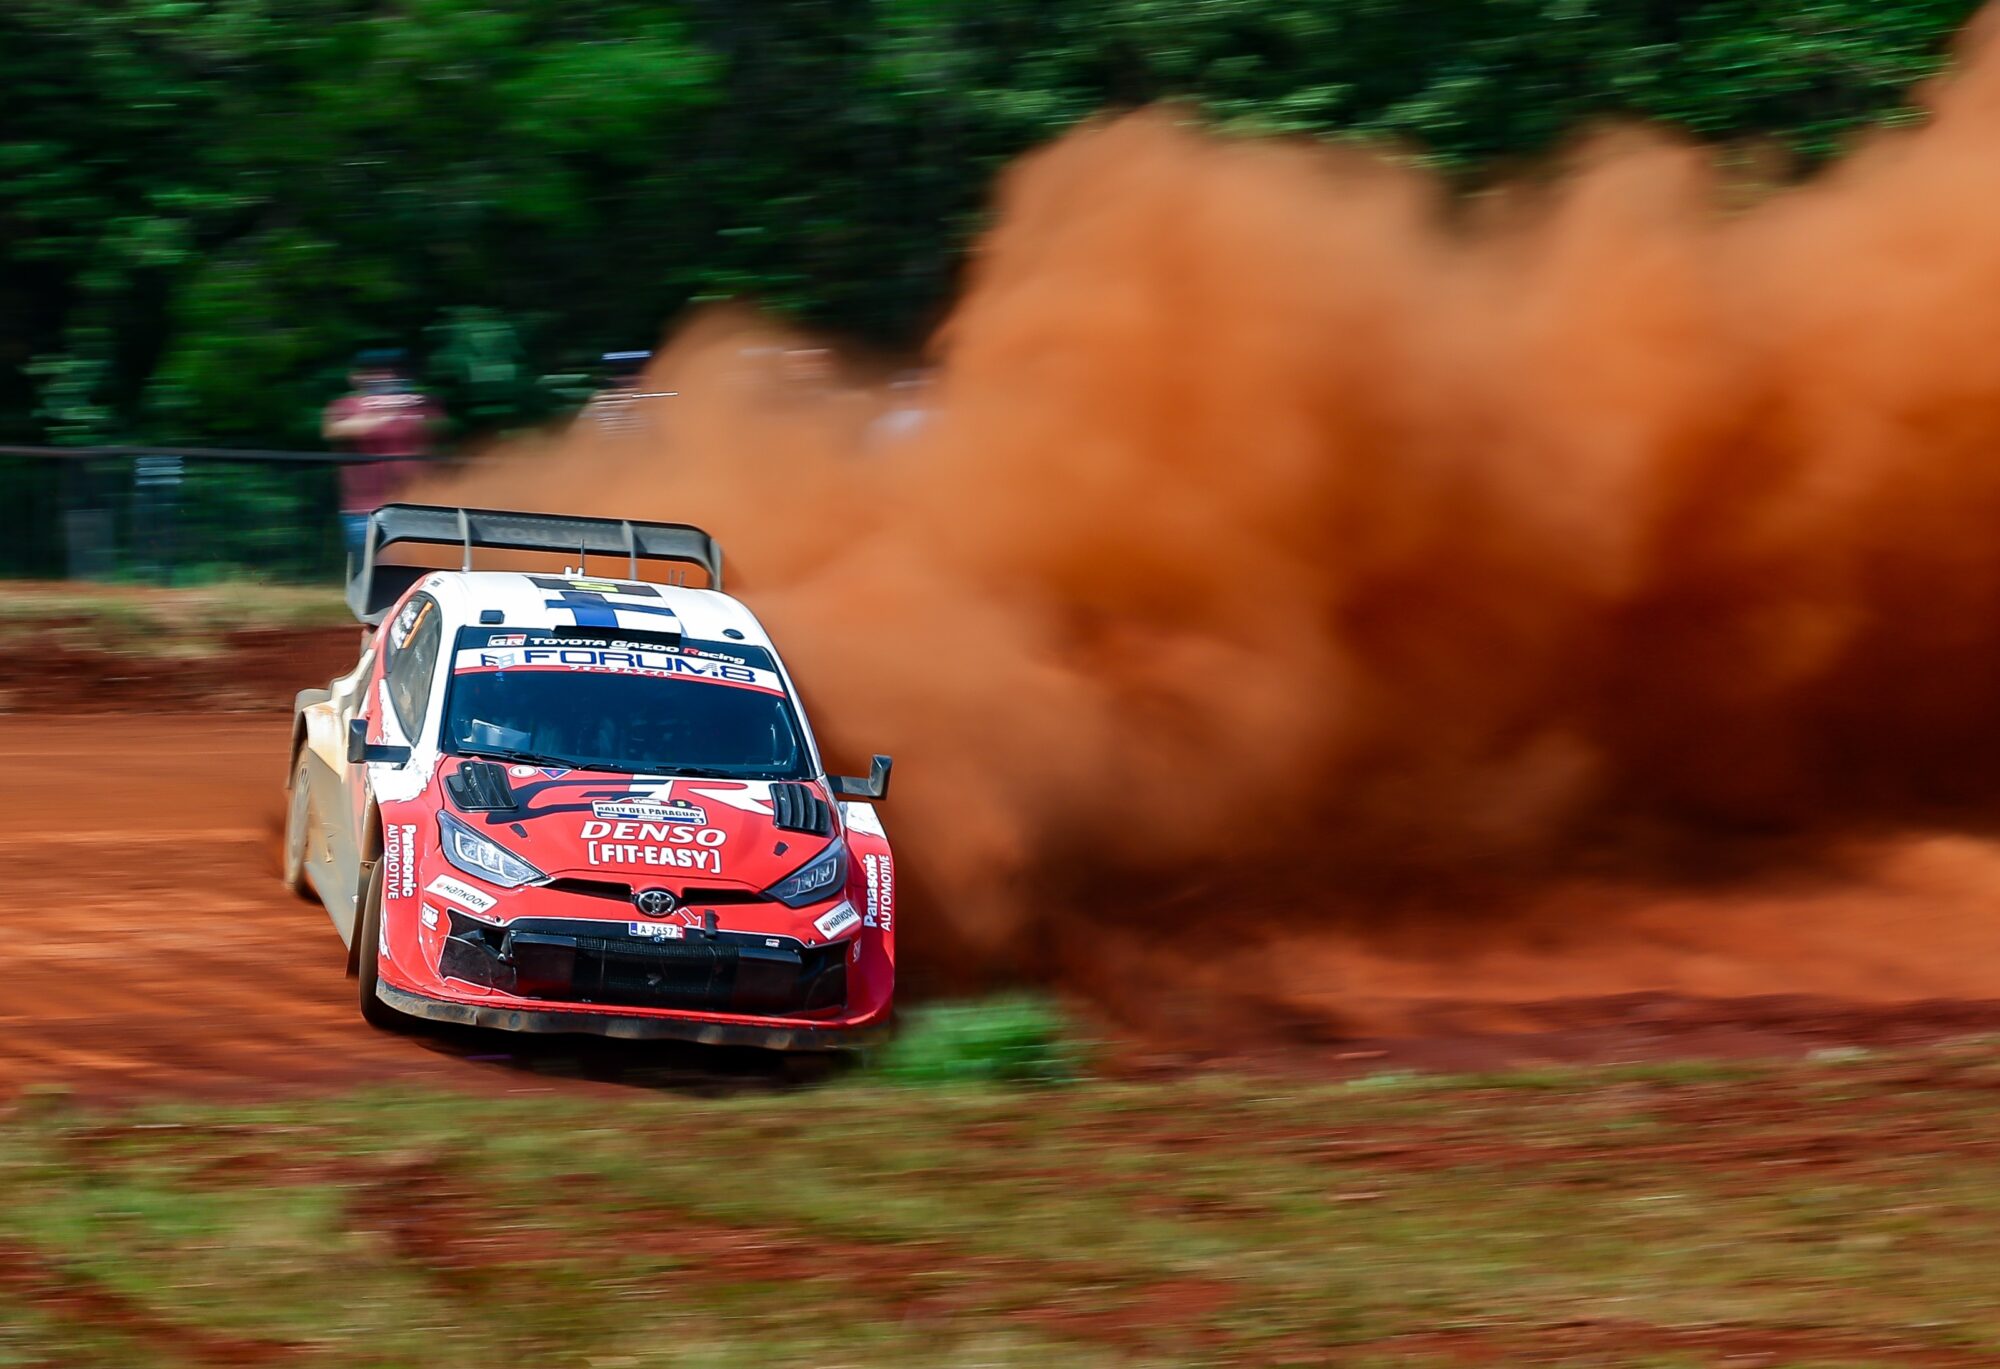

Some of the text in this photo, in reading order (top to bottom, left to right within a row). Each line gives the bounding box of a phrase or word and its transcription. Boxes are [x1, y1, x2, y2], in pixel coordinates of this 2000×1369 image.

[524, 649, 757, 684] FORUM8
[530, 637, 746, 665] TOYOTA GAZOO Racing
[597, 804, 626, 813] RALLY
[628, 806, 647, 815] DEL
[648, 807, 702, 818] PARAGUAY
[580, 821, 727, 848] DENSO
[386, 824, 399, 900] AUTOMOTIVE
[401, 824, 419, 898] Panasonic
[863, 853, 877, 928] Panasonic
[880, 854, 892, 931] AUTOMOTIVE
[640, 924, 674, 936] A-7657
